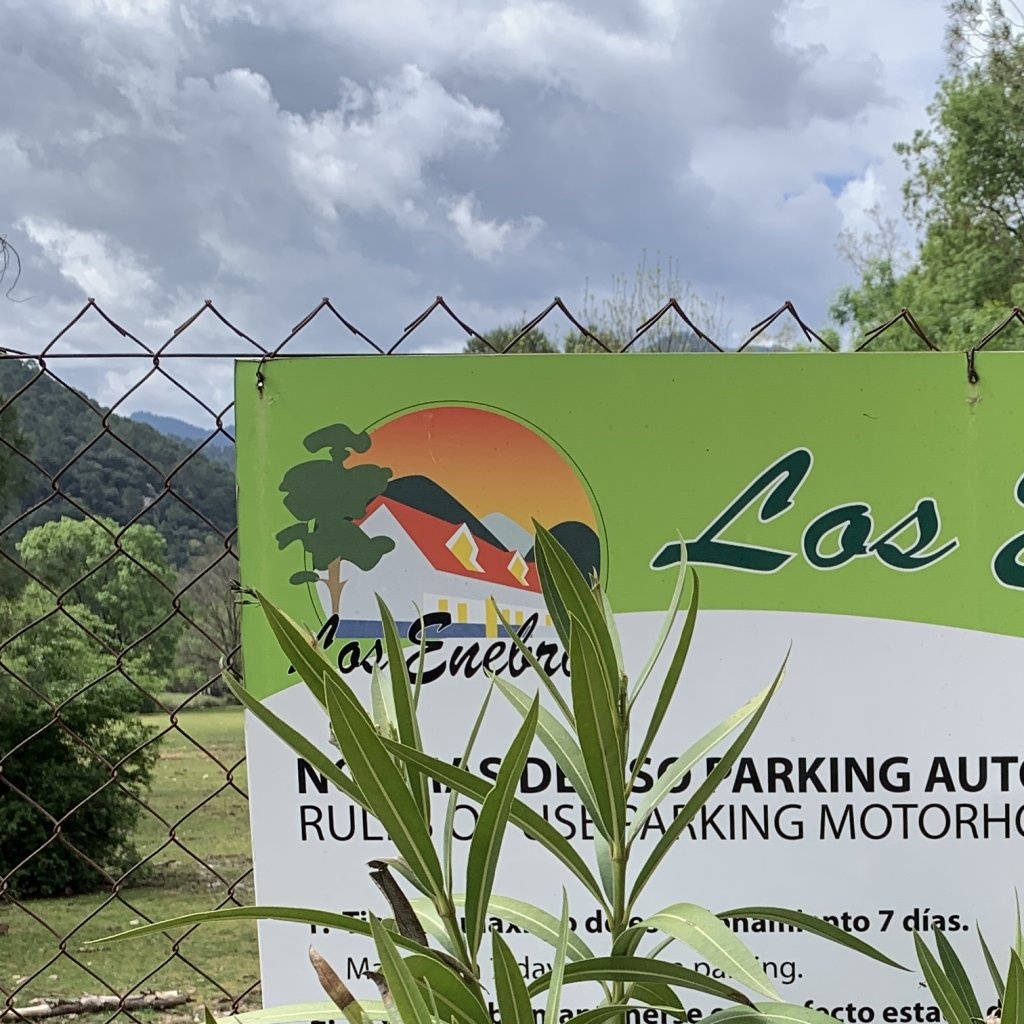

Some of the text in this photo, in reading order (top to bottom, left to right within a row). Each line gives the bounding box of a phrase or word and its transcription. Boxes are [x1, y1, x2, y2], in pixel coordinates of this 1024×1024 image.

[650, 446, 960, 574] Los
[403, 612, 572, 685] Enebr
[706, 756, 910, 793] PARKING
[300, 805, 432, 841] RUL
[878, 911, 894, 932] 7
[902, 907, 969, 933] días.
[882, 1002, 946, 1023] esta
